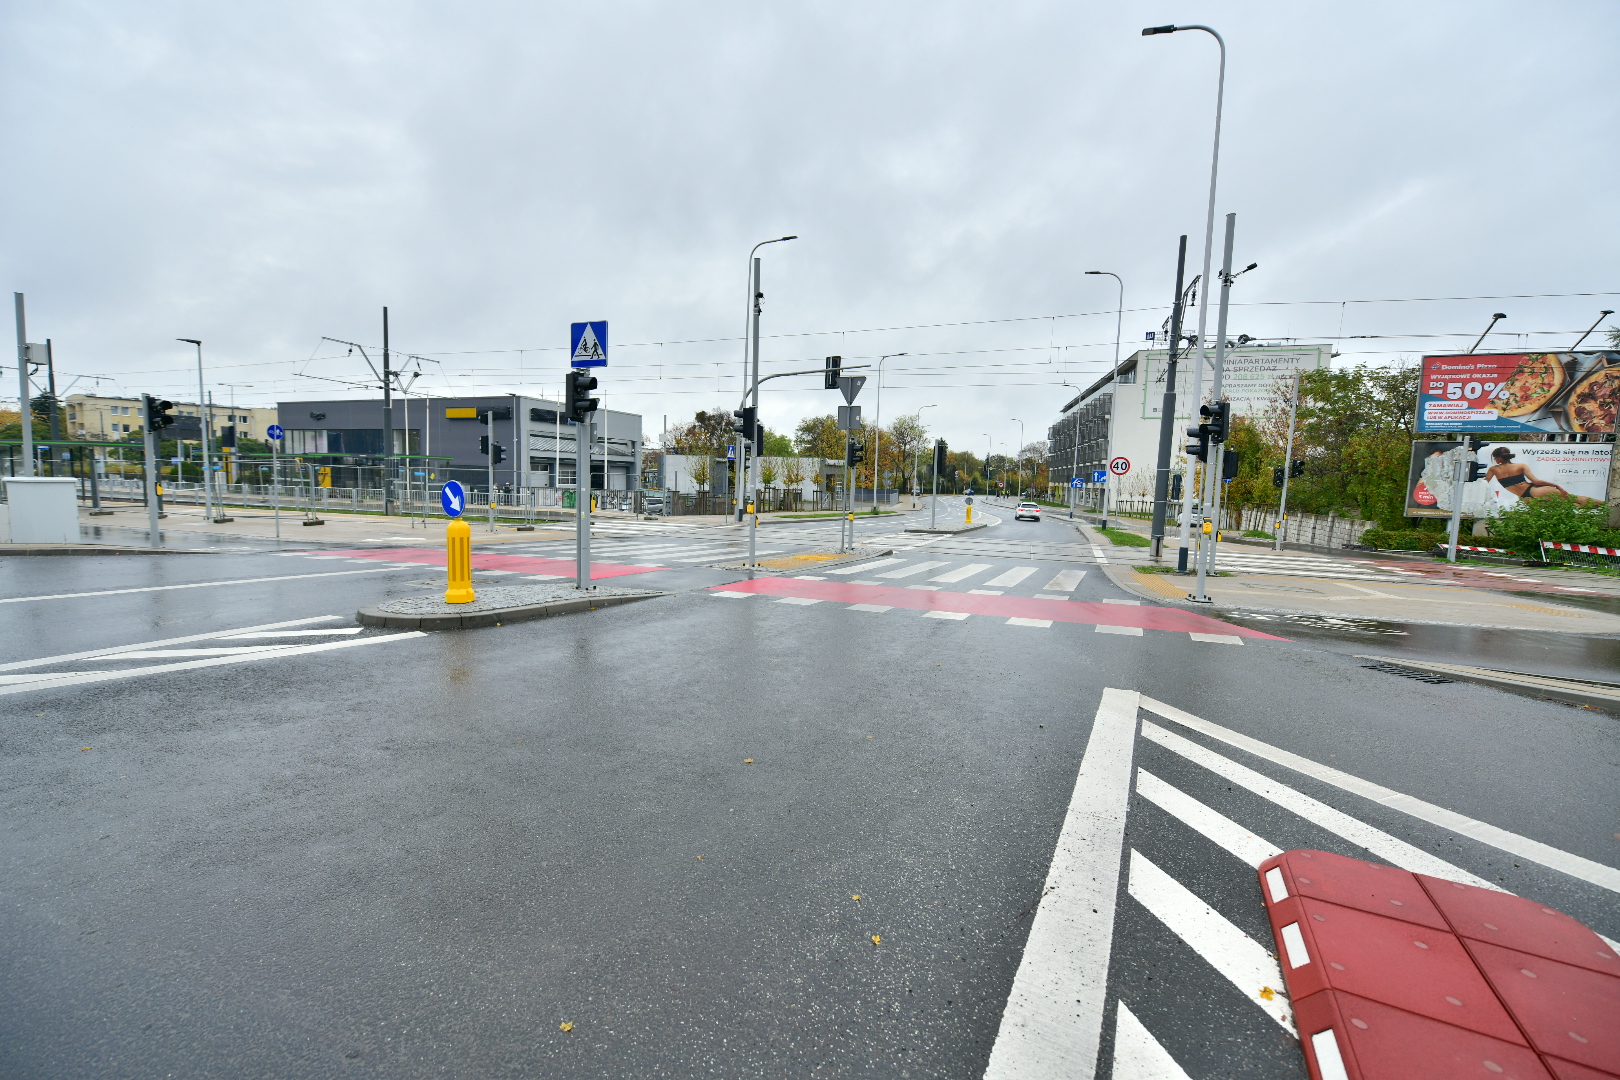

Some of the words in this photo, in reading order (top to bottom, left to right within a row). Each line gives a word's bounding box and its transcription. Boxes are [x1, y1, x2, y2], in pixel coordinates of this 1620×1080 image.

[1522, 448, 1561, 456] Wyrzeźb
[1563, 448, 1576, 456] się
[1113, 461, 1128, 471] 40
